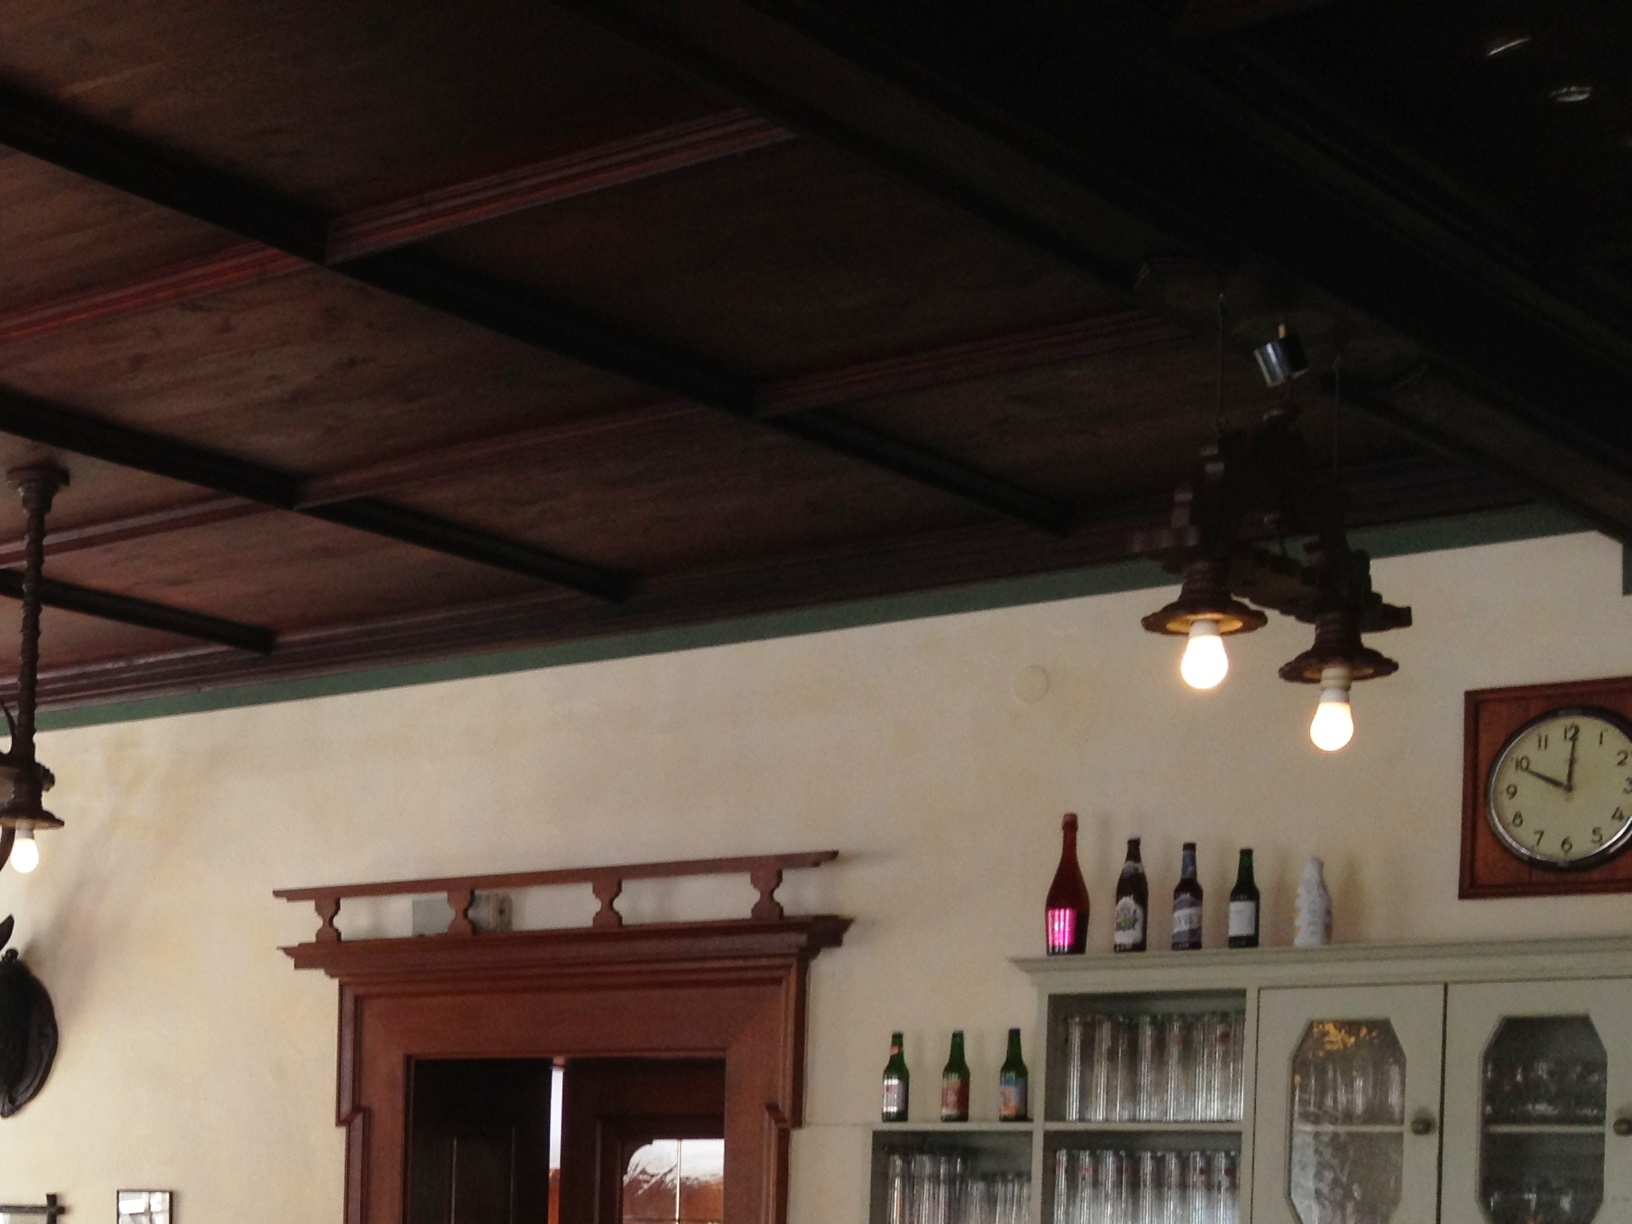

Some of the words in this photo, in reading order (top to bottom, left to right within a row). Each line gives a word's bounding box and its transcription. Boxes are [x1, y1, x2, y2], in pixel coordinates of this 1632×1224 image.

[1563, 725, 1581, 741] 12
[1537, 733, 1549, 750] 11
[1513, 756, 1531, 772] 10
[1616, 750, 1629, 767] 2
[1505, 784, 1518, 800] 9
[1512, 811, 1524, 827] 8
[1611, 806, 1625, 821] 4
[1533, 830, 1545, 847] 7
[1592, 827, 1603, 844] 5
[1560, 837, 1573, 854] 6
